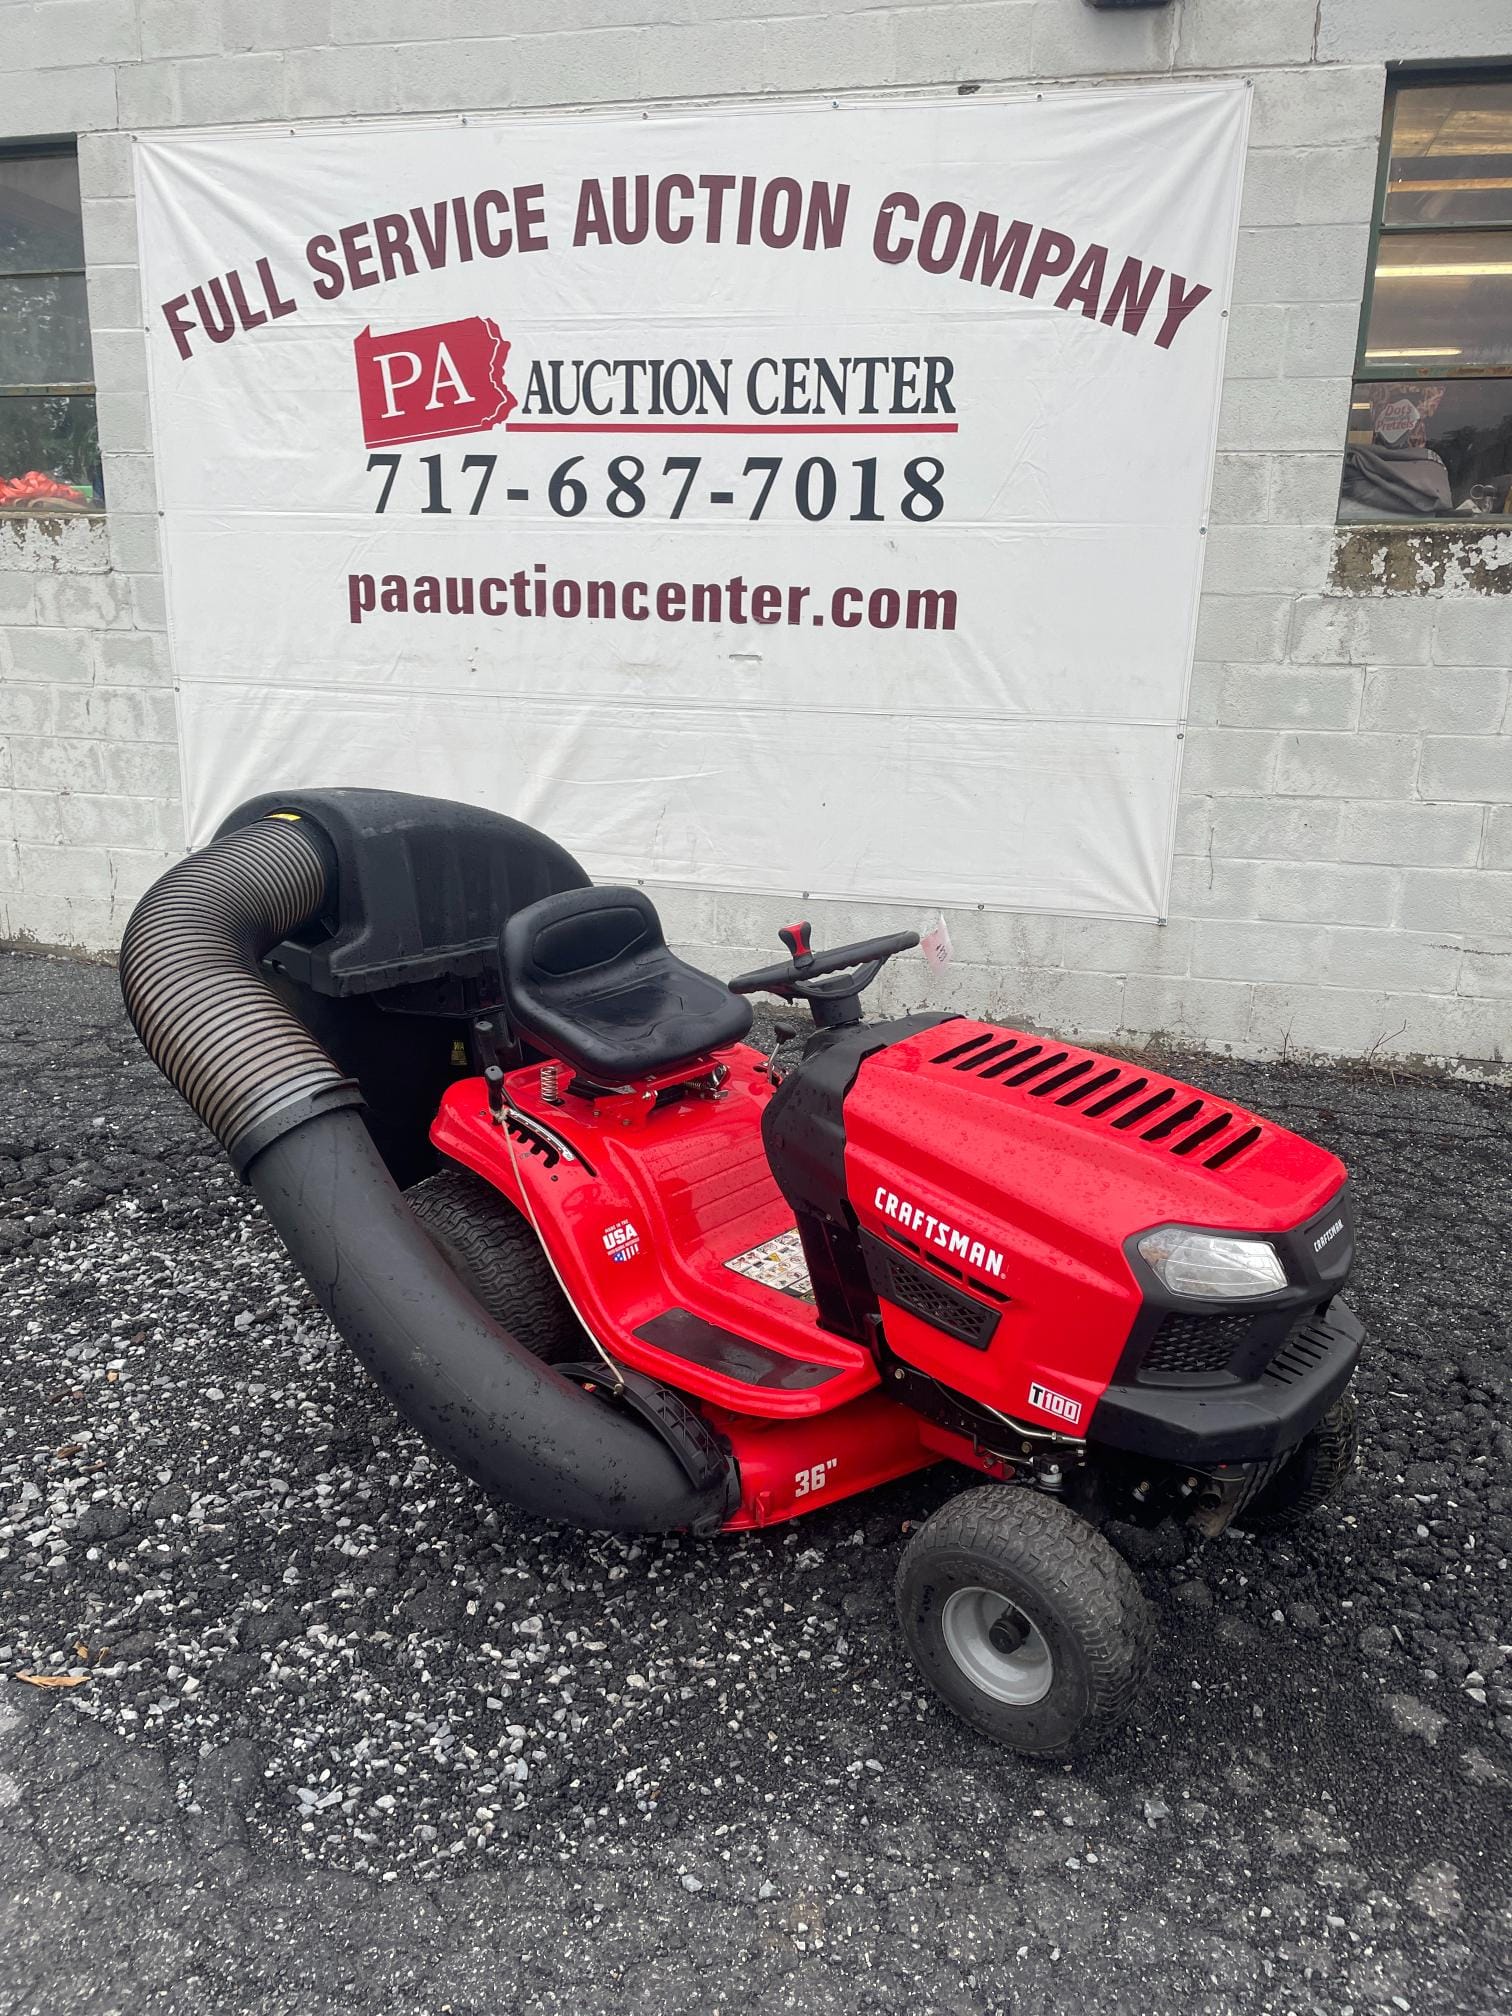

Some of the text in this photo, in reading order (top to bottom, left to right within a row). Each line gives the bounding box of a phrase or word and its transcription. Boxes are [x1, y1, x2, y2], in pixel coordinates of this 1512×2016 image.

[162, 173, 1212, 361] FULL SERVICE AUCTION COMPANY
[373, 341, 956, 419] PA AUCTION CENTER
[366, 453, 945, 523] 717-687-7018
[348, 564, 958, 631] paauctioncenter.com
[602, 1223, 638, 1250] USA
[875, 1187, 1003, 1276] CRAFTSMAN
[1313, 1218, 1344, 1252] CRAFTSMAN
[1032, 1385, 1078, 1420] T100
[795, 1458, 837, 1497] 36"
